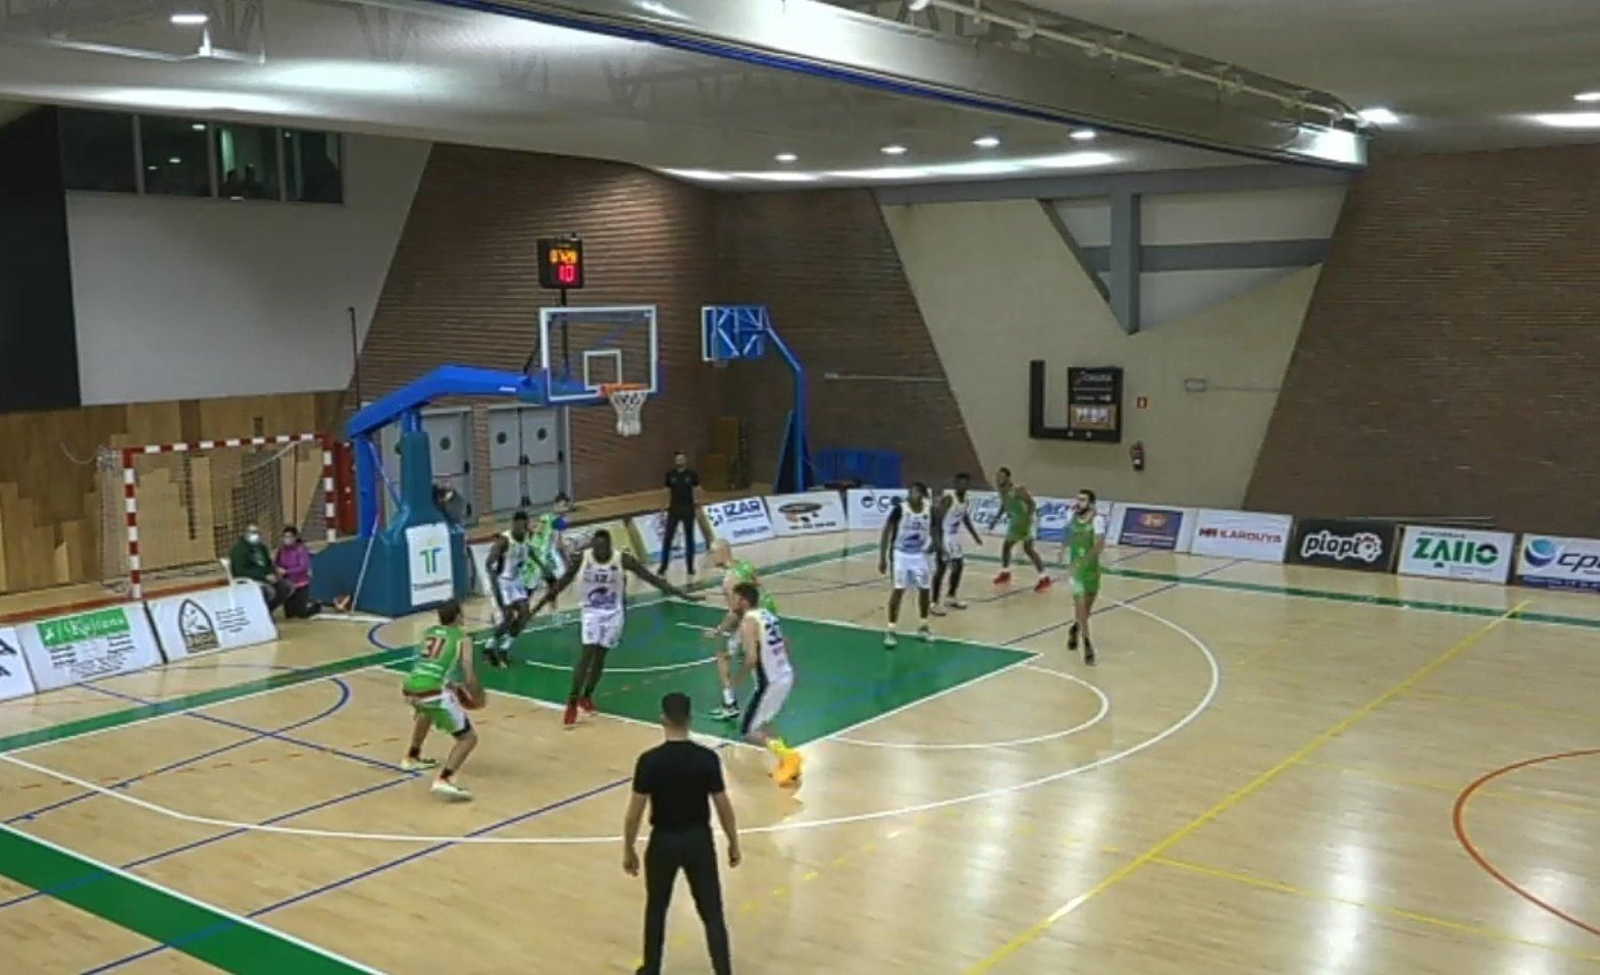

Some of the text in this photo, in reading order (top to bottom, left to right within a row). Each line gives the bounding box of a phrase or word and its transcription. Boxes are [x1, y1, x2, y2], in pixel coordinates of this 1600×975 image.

[559, 265, 574, 282] 10
[723, 500, 760, 516] IZAR
[421, 635, 446, 660] 31
